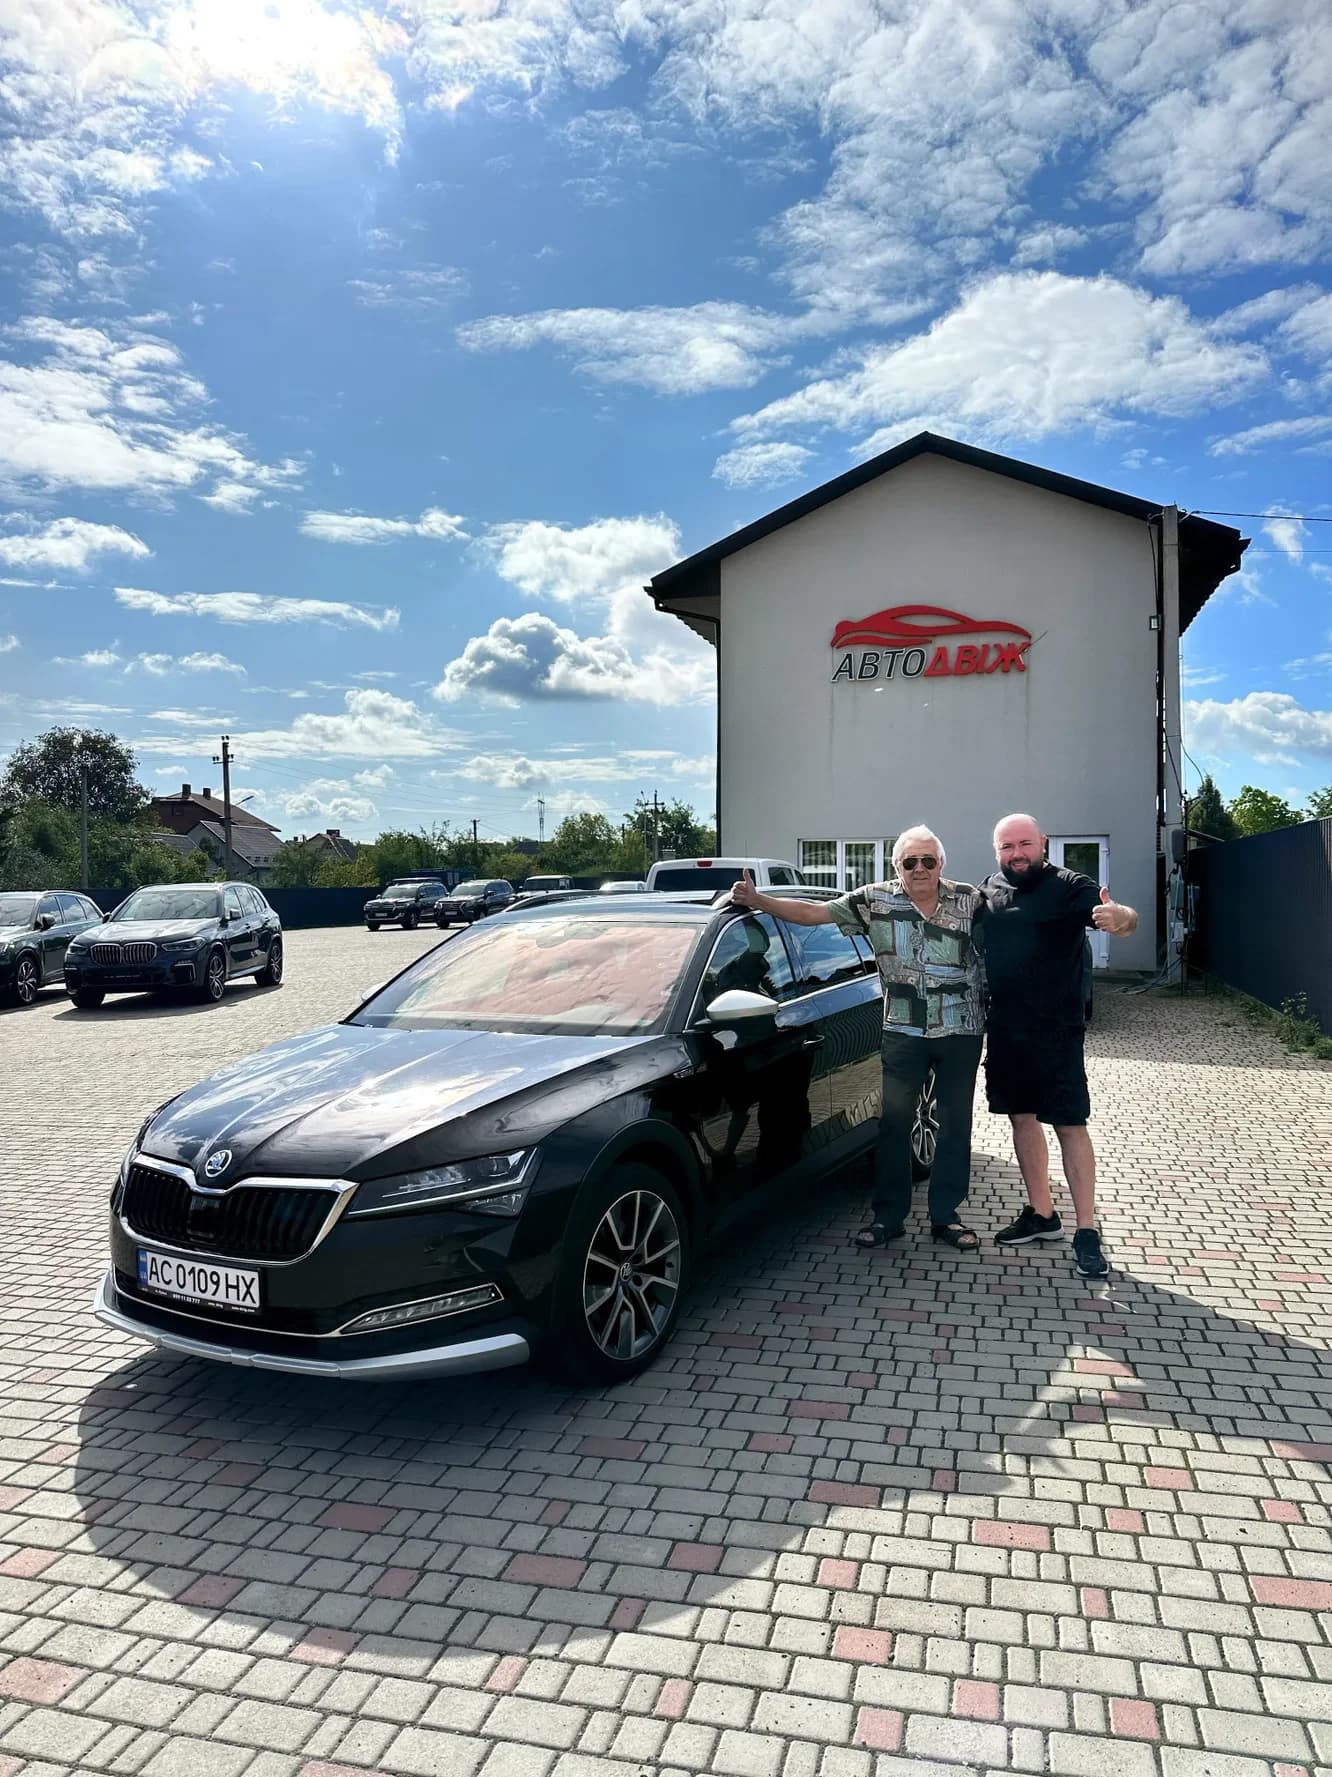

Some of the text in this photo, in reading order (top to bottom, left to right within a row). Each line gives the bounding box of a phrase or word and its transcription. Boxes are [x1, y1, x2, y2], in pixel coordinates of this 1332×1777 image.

[149, 1257, 256, 1304] AC 0109 HX
